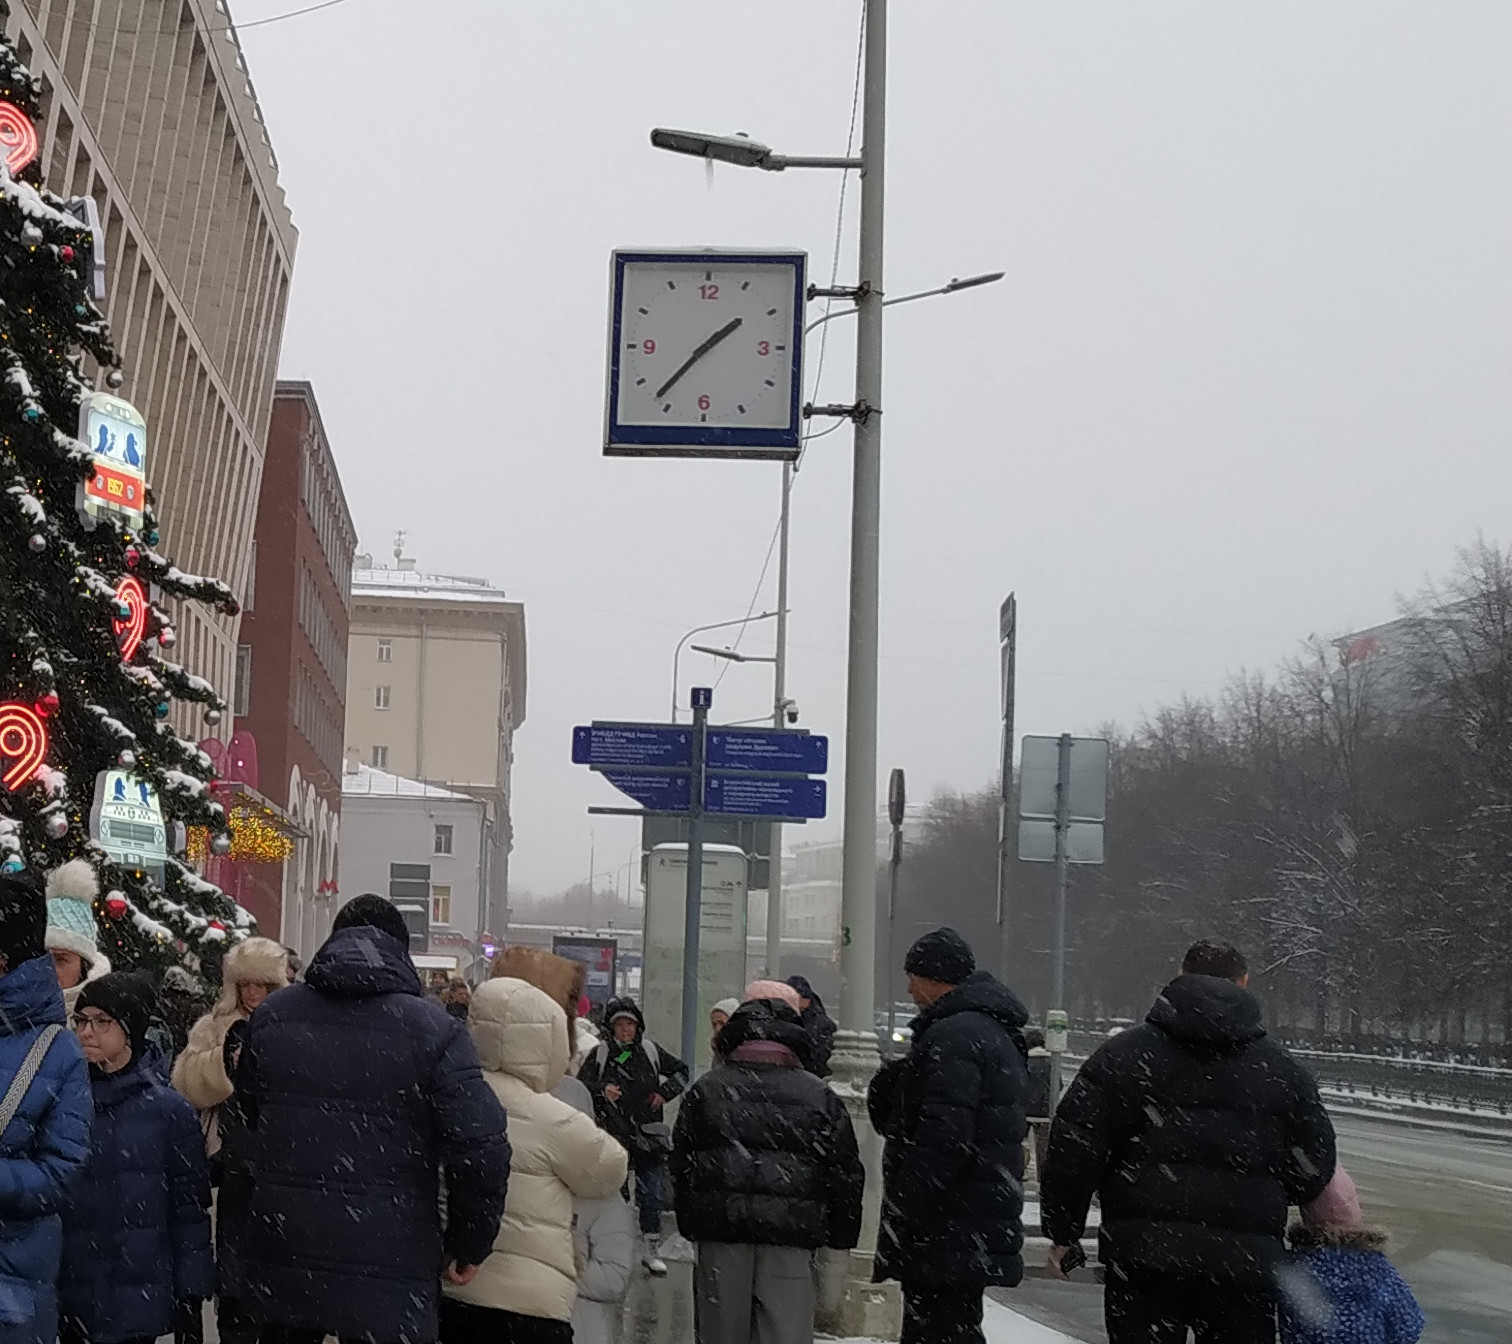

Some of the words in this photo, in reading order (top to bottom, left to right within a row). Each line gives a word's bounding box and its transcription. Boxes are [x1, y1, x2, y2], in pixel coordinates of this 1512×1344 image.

[698, 285, 719, 300] 12
[643, 340, 656, 355] 9
[757, 341, 769, 356] 3
[698, 395, 710, 410] 6
